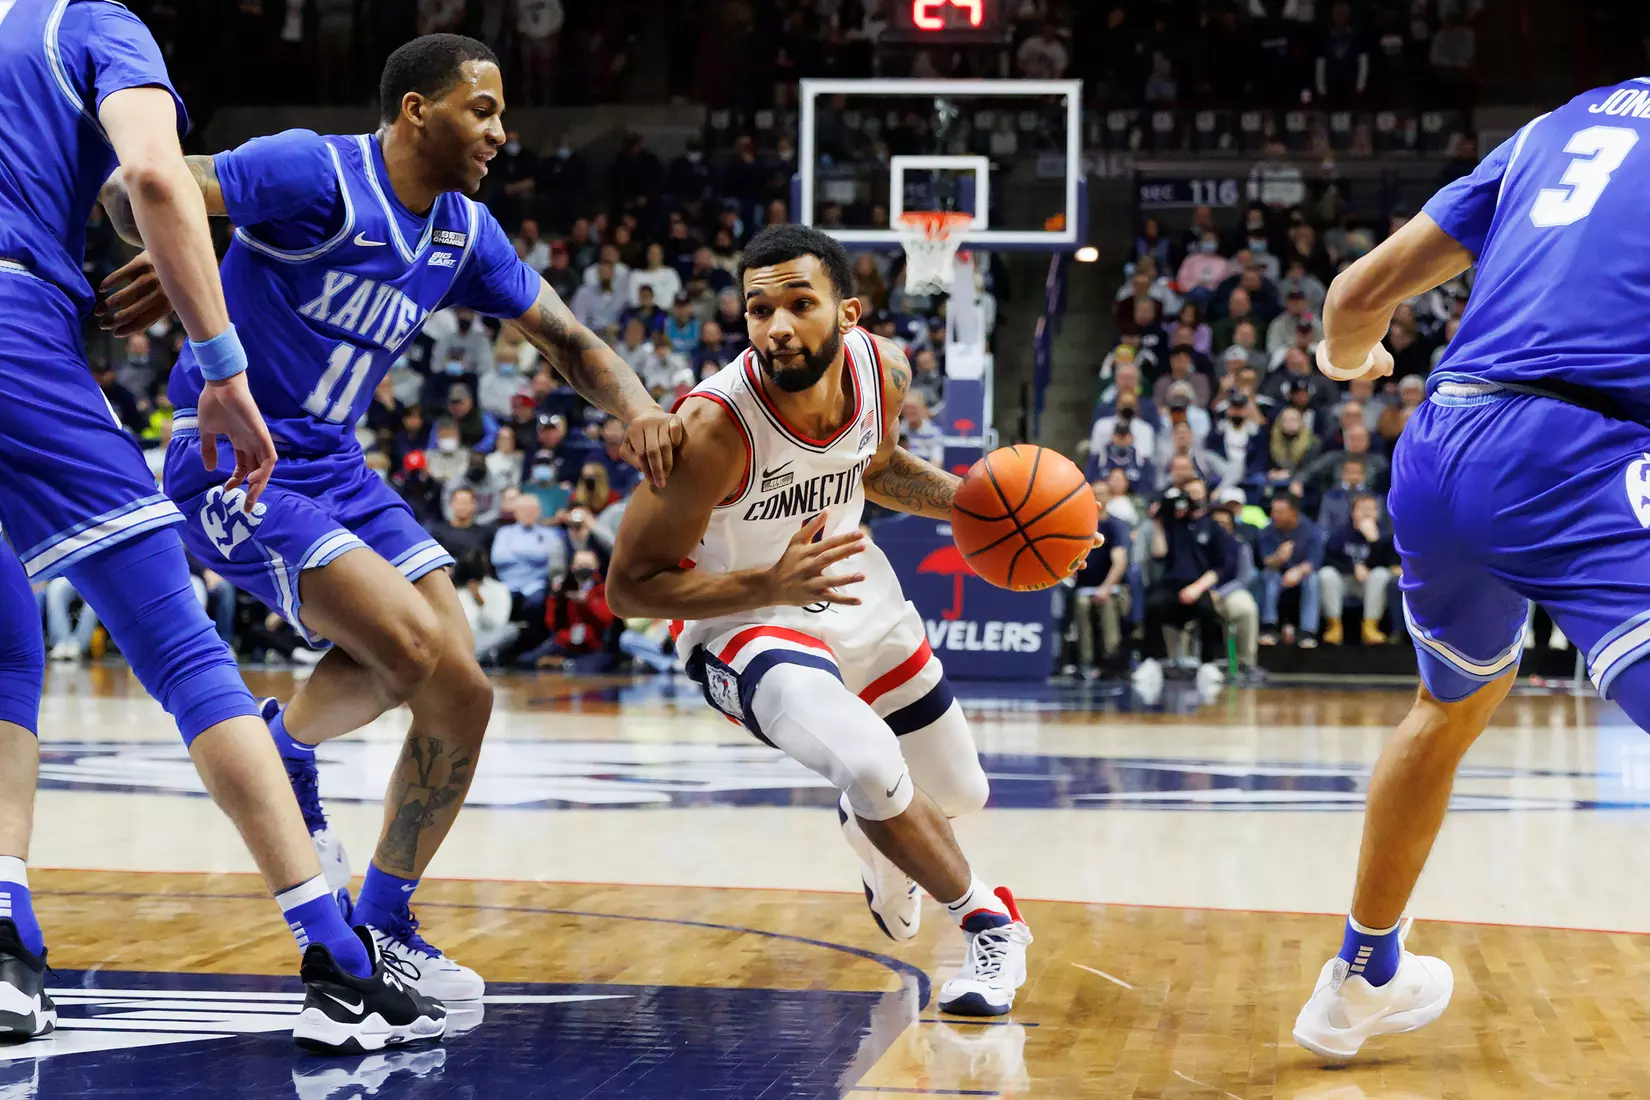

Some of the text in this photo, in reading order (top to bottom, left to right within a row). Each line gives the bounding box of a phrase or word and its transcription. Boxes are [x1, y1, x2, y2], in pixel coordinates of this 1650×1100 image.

[1189, 178, 1239, 206] 116
[1529, 125, 1640, 227] 3
[296, 269, 428, 353] XAVIE
[302, 341, 374, 425] 11
[925, 618, 1044, 653] VELERS
